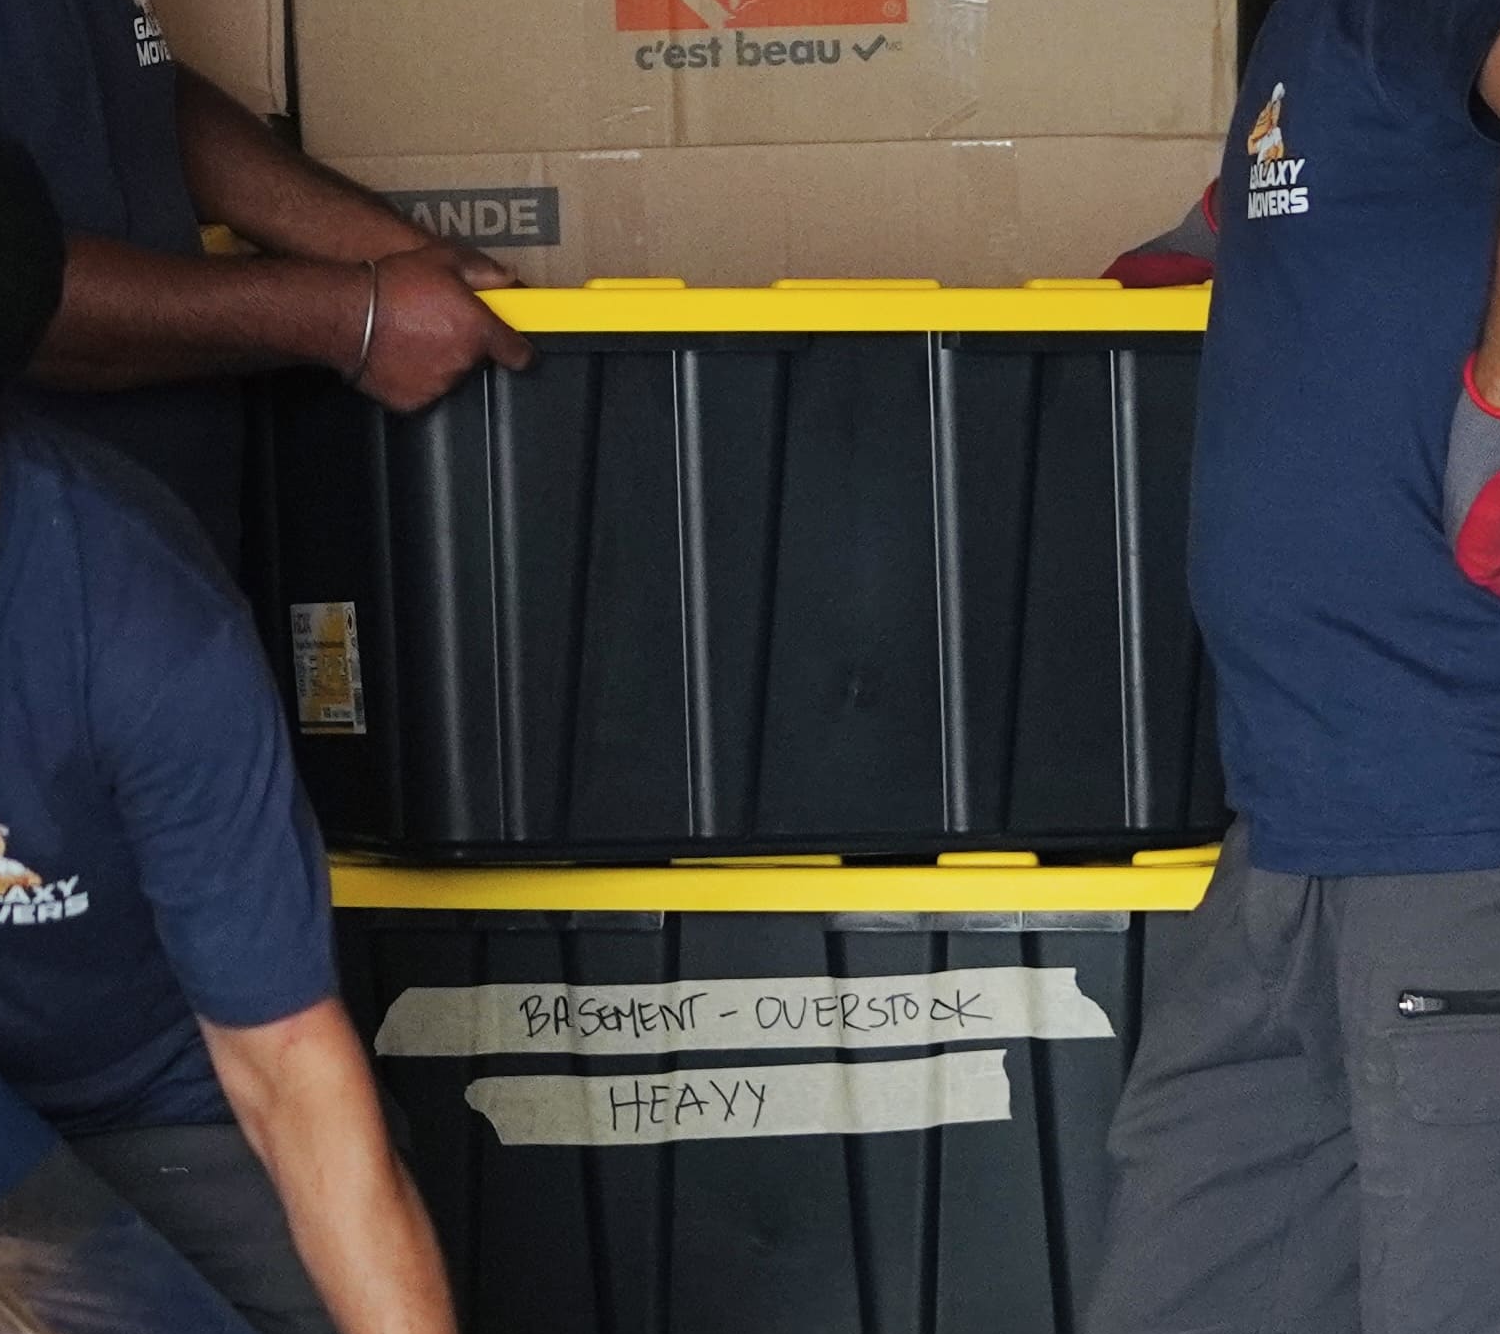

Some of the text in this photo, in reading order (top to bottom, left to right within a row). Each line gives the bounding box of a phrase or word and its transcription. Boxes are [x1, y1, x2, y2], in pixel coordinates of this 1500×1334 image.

[735, 30, 841, 67] beau
[412, 198, 541, 237] ANDE
[1248, 187, 1309, 219] MOVERS
[520, 992, 708, 1038] BASEMENT
